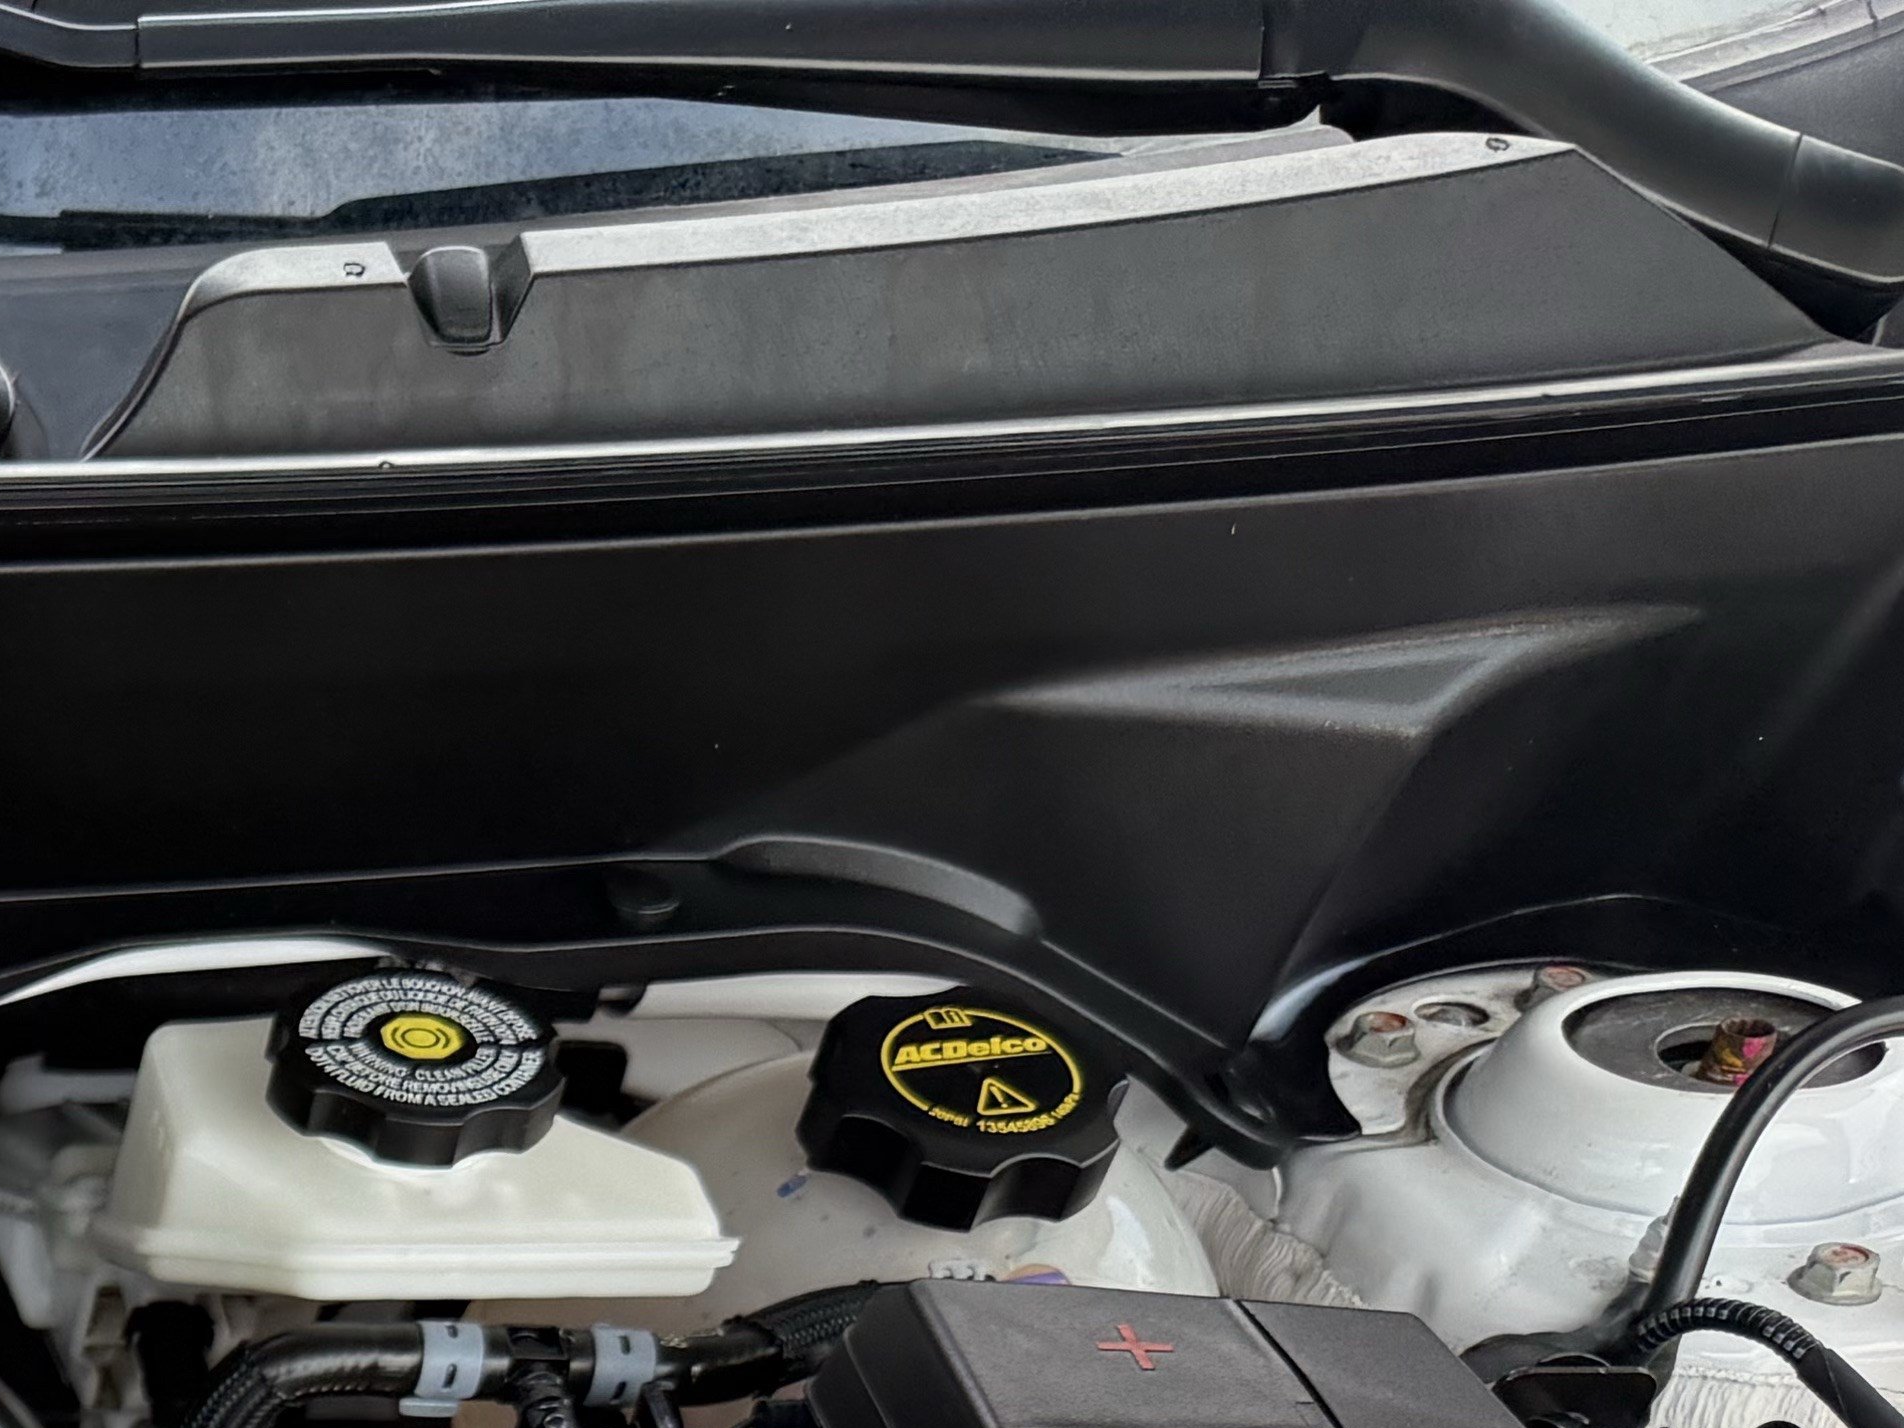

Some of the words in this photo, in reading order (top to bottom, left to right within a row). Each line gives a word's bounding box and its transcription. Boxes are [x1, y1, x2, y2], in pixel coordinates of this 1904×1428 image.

[894, 1036, 1048, 1065] ACDelco
[337, 1067, 377, 1094] FLUID
[372, 1080, 426, 1105] FROM
[424, 1092, 437, 1106] A
[435, 1088, 495, 1107] SEALED
[414, 1063, 466, 1083] CLEAN
